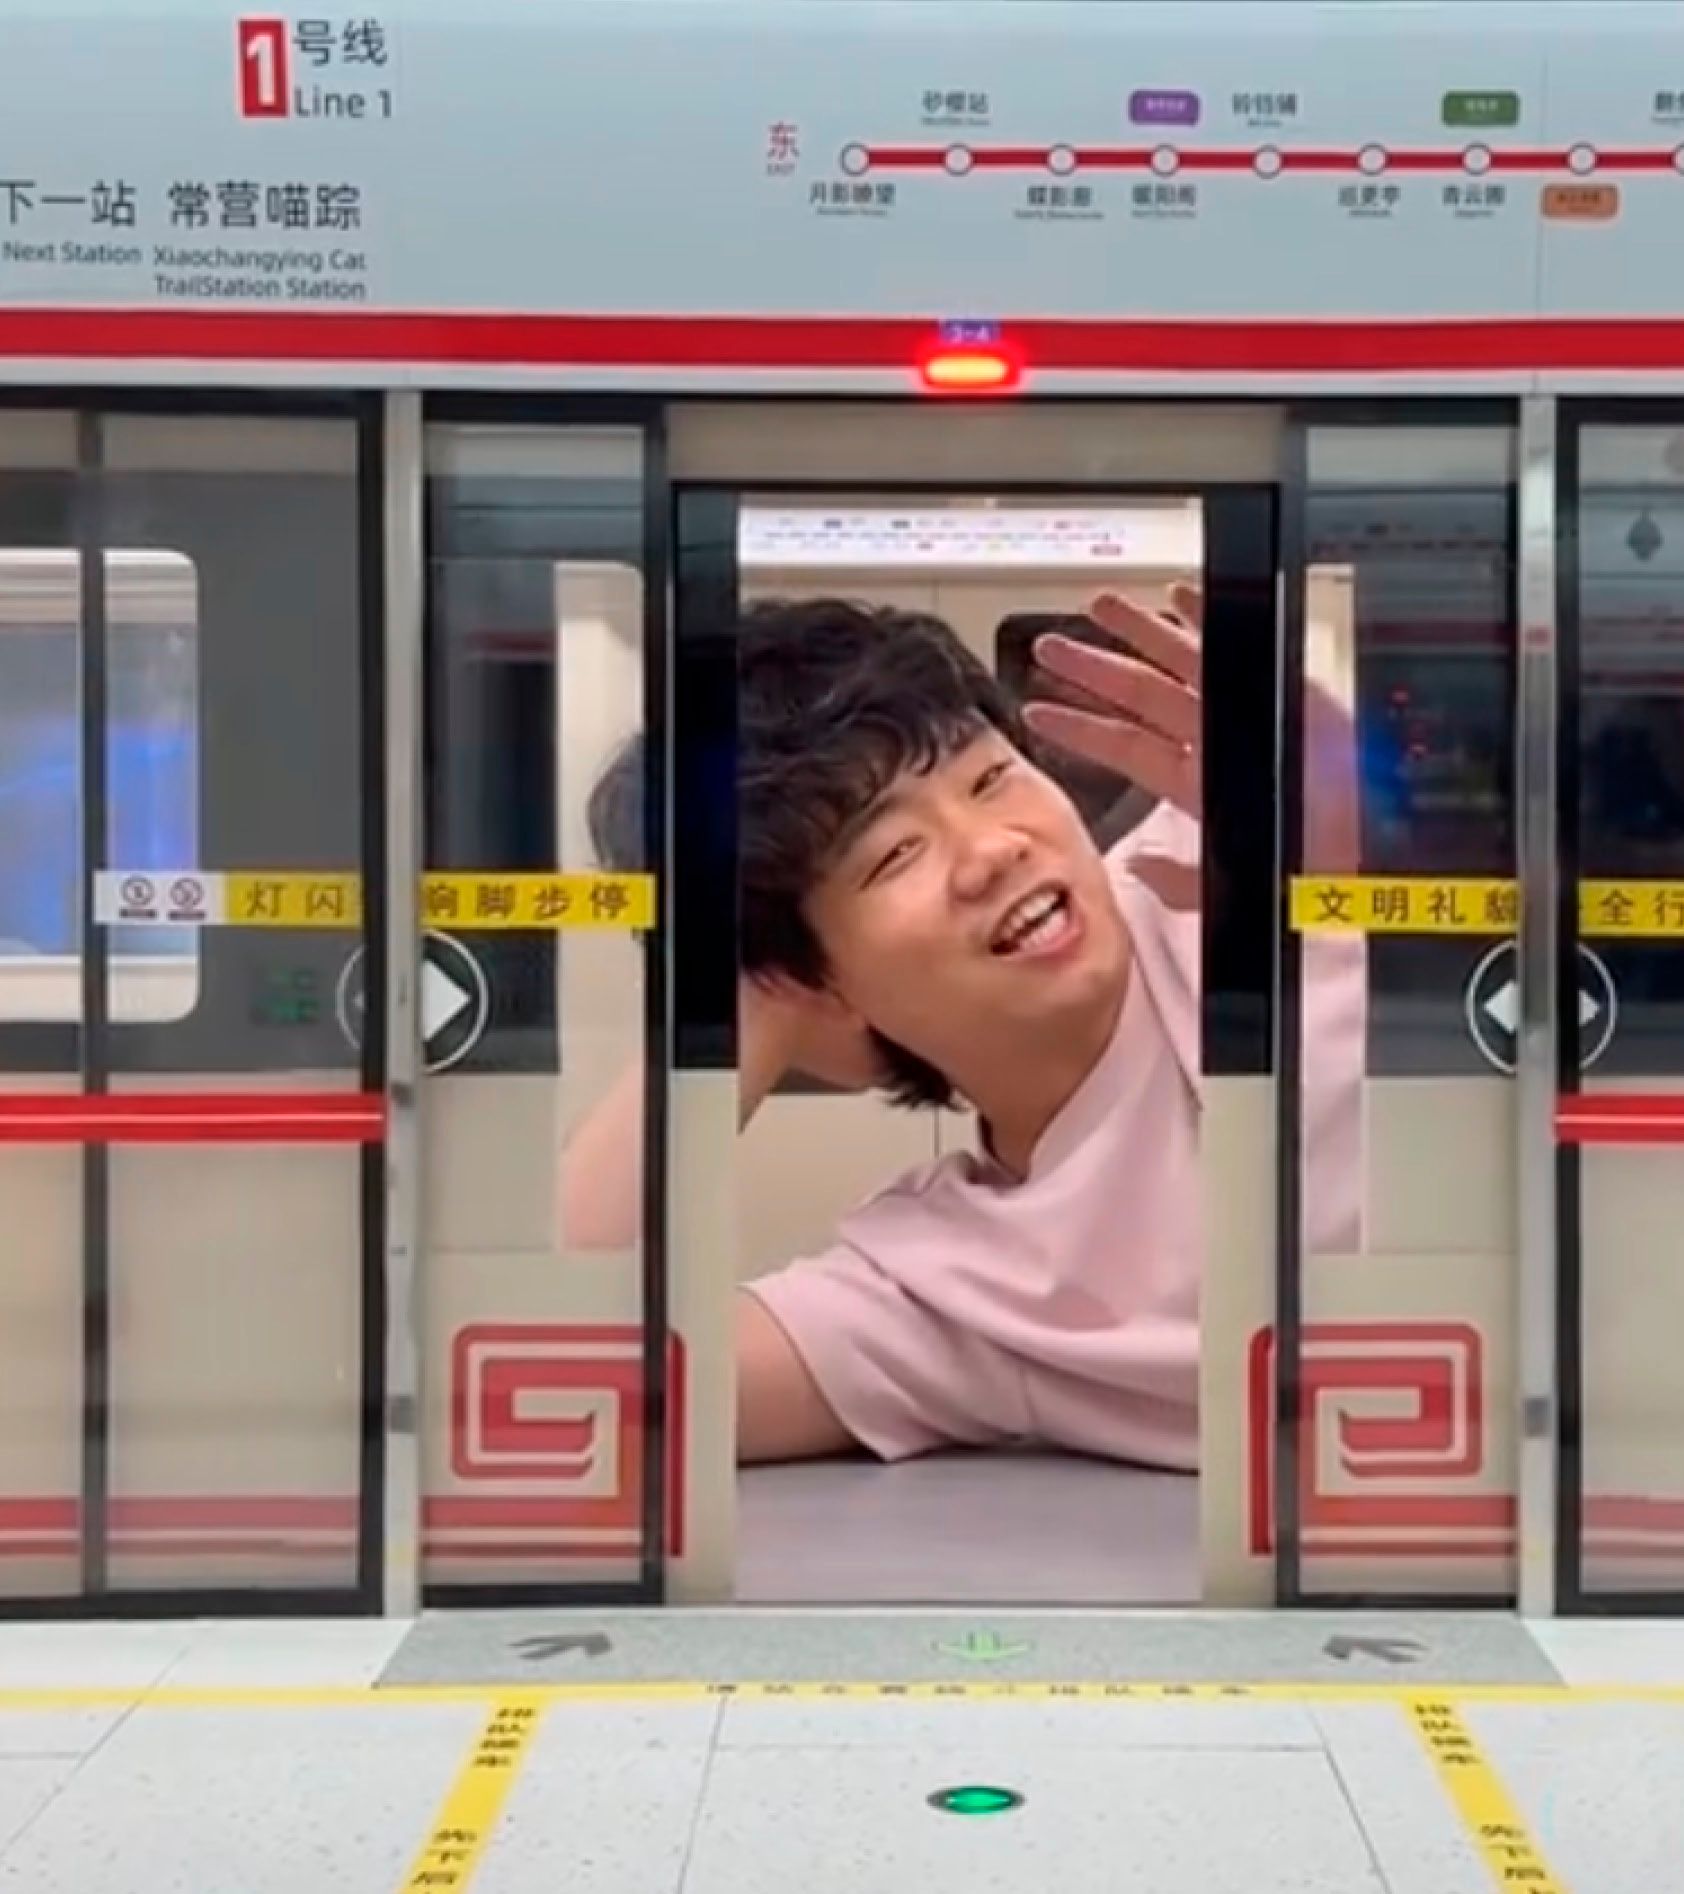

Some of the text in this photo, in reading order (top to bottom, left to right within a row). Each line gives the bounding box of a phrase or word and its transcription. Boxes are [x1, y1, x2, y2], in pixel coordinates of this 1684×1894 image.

[245, 18, 388, 106] 1 号线
[294, 84, 392, 118] Line 1
[767, 121, 800, 159] 东
[0, 179, 137, 227] 下一站
[2, 240, 54, 264] Next
[60, 240, 143, 264] Station
[285, 275, 366, 300] Station
